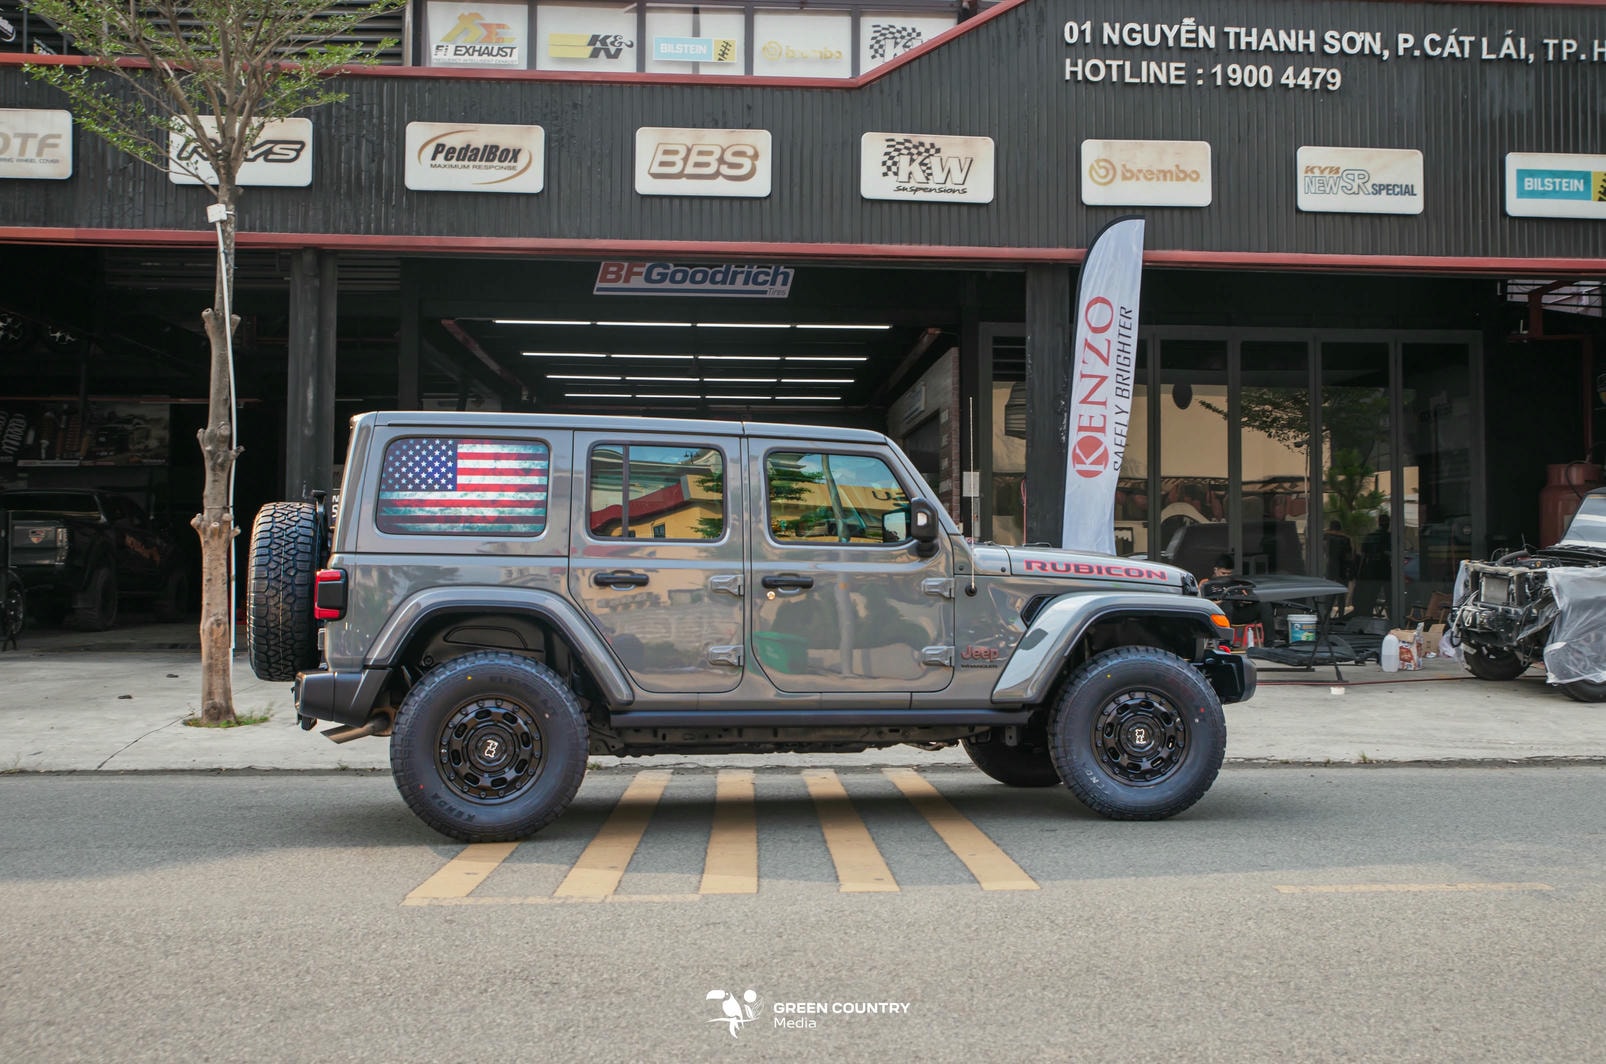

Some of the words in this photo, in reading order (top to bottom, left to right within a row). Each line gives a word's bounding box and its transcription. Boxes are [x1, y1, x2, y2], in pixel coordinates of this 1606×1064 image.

[587, 34, 634, 60] K&N
[659, 42, 708, 56] BILSTEIN
[1063, 20, 1092, 45] 01
[1102, 17, 1216, 49] NGUYỄN
[1223, 26, 1316, 53] THANH
[1322, 30, 1390, 61] SƠN,
[1481, 30, 1535, 63] LÁI,
[454, 45, 518, 58] EXHAUST
[1064, 58, 1187, 86] HOTLINE
[1211, 64, 1273, 88] 1900
[1280, 65, 1343, 91] 4479
[176, 137, 306, 163] RYS
[431, 142, 522, 163] PedalBox
[647, 142, 760, 182] BBS
[896, 152, 974, 186] KW
[1304, 165, 1341, 176] KYB
[1120, 164, 1202, 183] brembo
[893, 185, 968, 196] suspensions
[1304, 176, 1341, 195] NEW
[1371, 182, 1418, 197] SPECIAL
[1523, 177, 1585, 193] BILSTEIN
[598, 262, 791, 287] BFGoodrich
[767, 287, 787, 297] Tires
[1115, 305, 1133, 400] BRIGHTER
[1072, 295, 1114, 479] KENZO
[1024, 559, 1168, 581] RUBICON
[960, 644, 999, 662] Jeep
